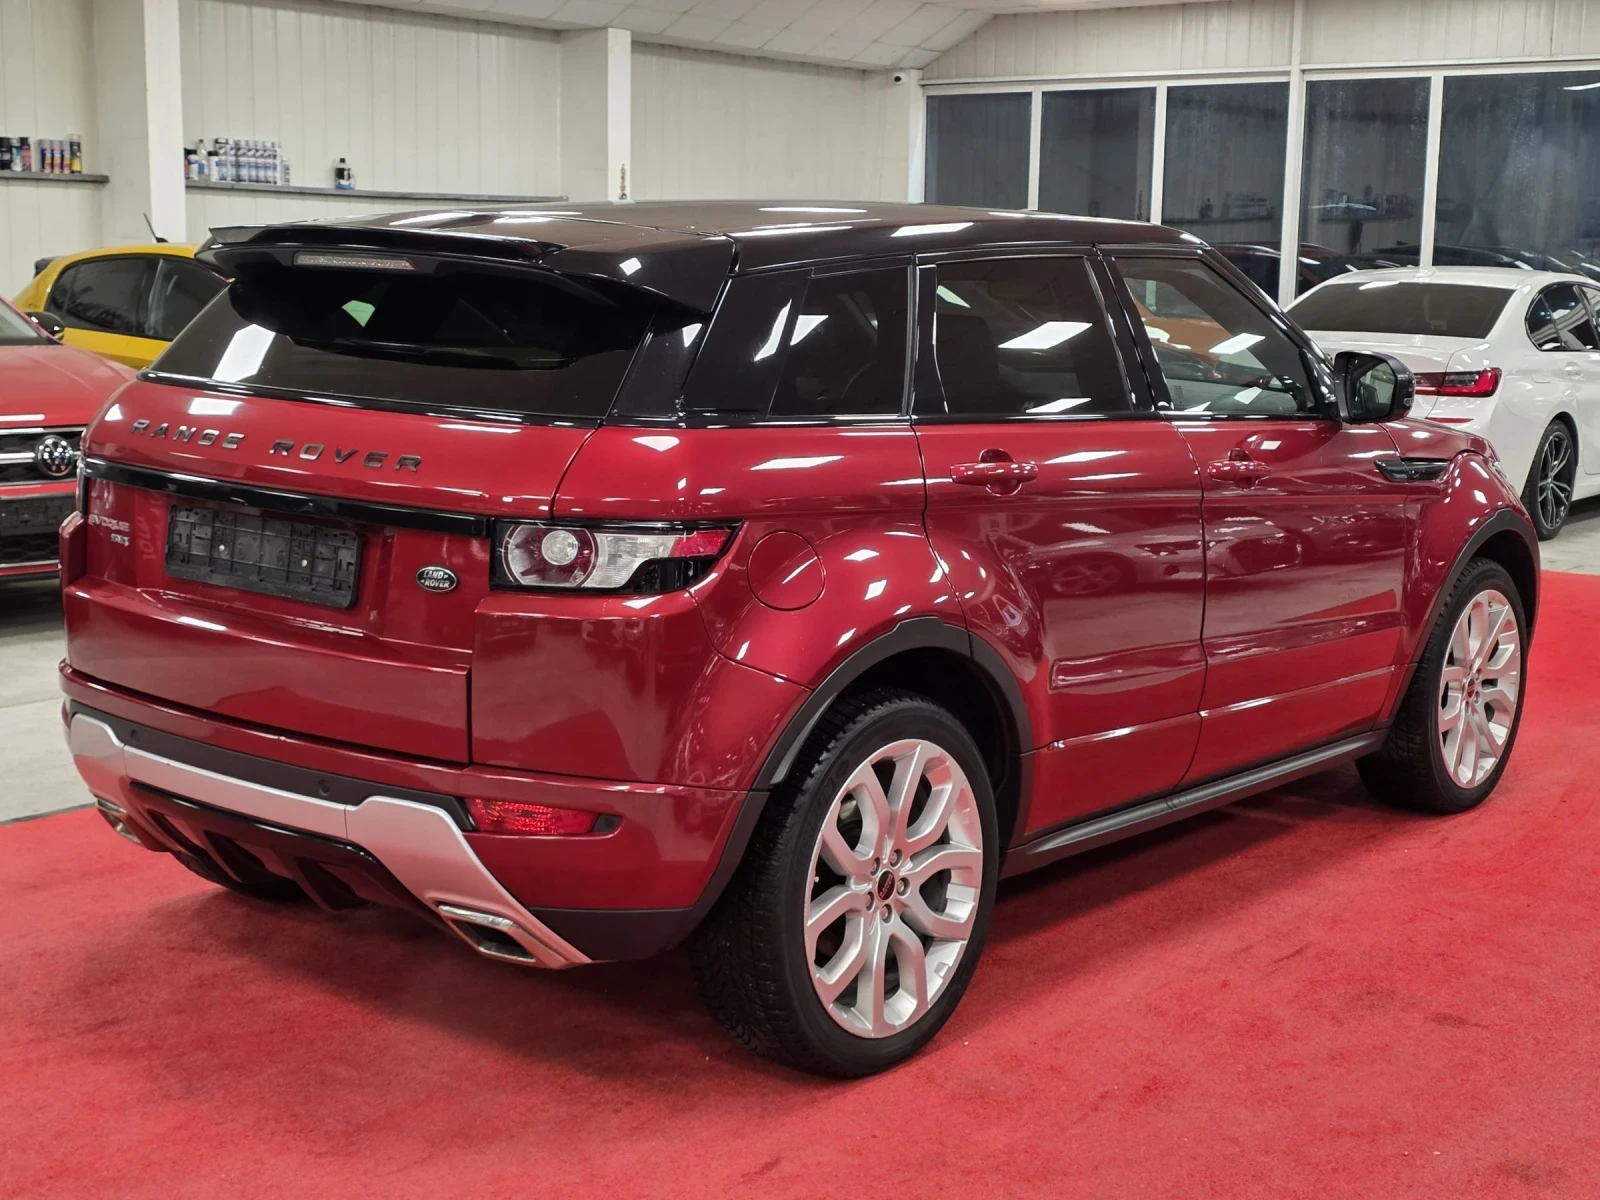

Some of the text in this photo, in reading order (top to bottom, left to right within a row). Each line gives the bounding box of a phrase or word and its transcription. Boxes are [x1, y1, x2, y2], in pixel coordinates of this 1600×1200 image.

[131, 419, 422, 472] RANGE ROVER
[423, 569, 444, 579] LAND
[424, 578, 451, 589] ROVER
